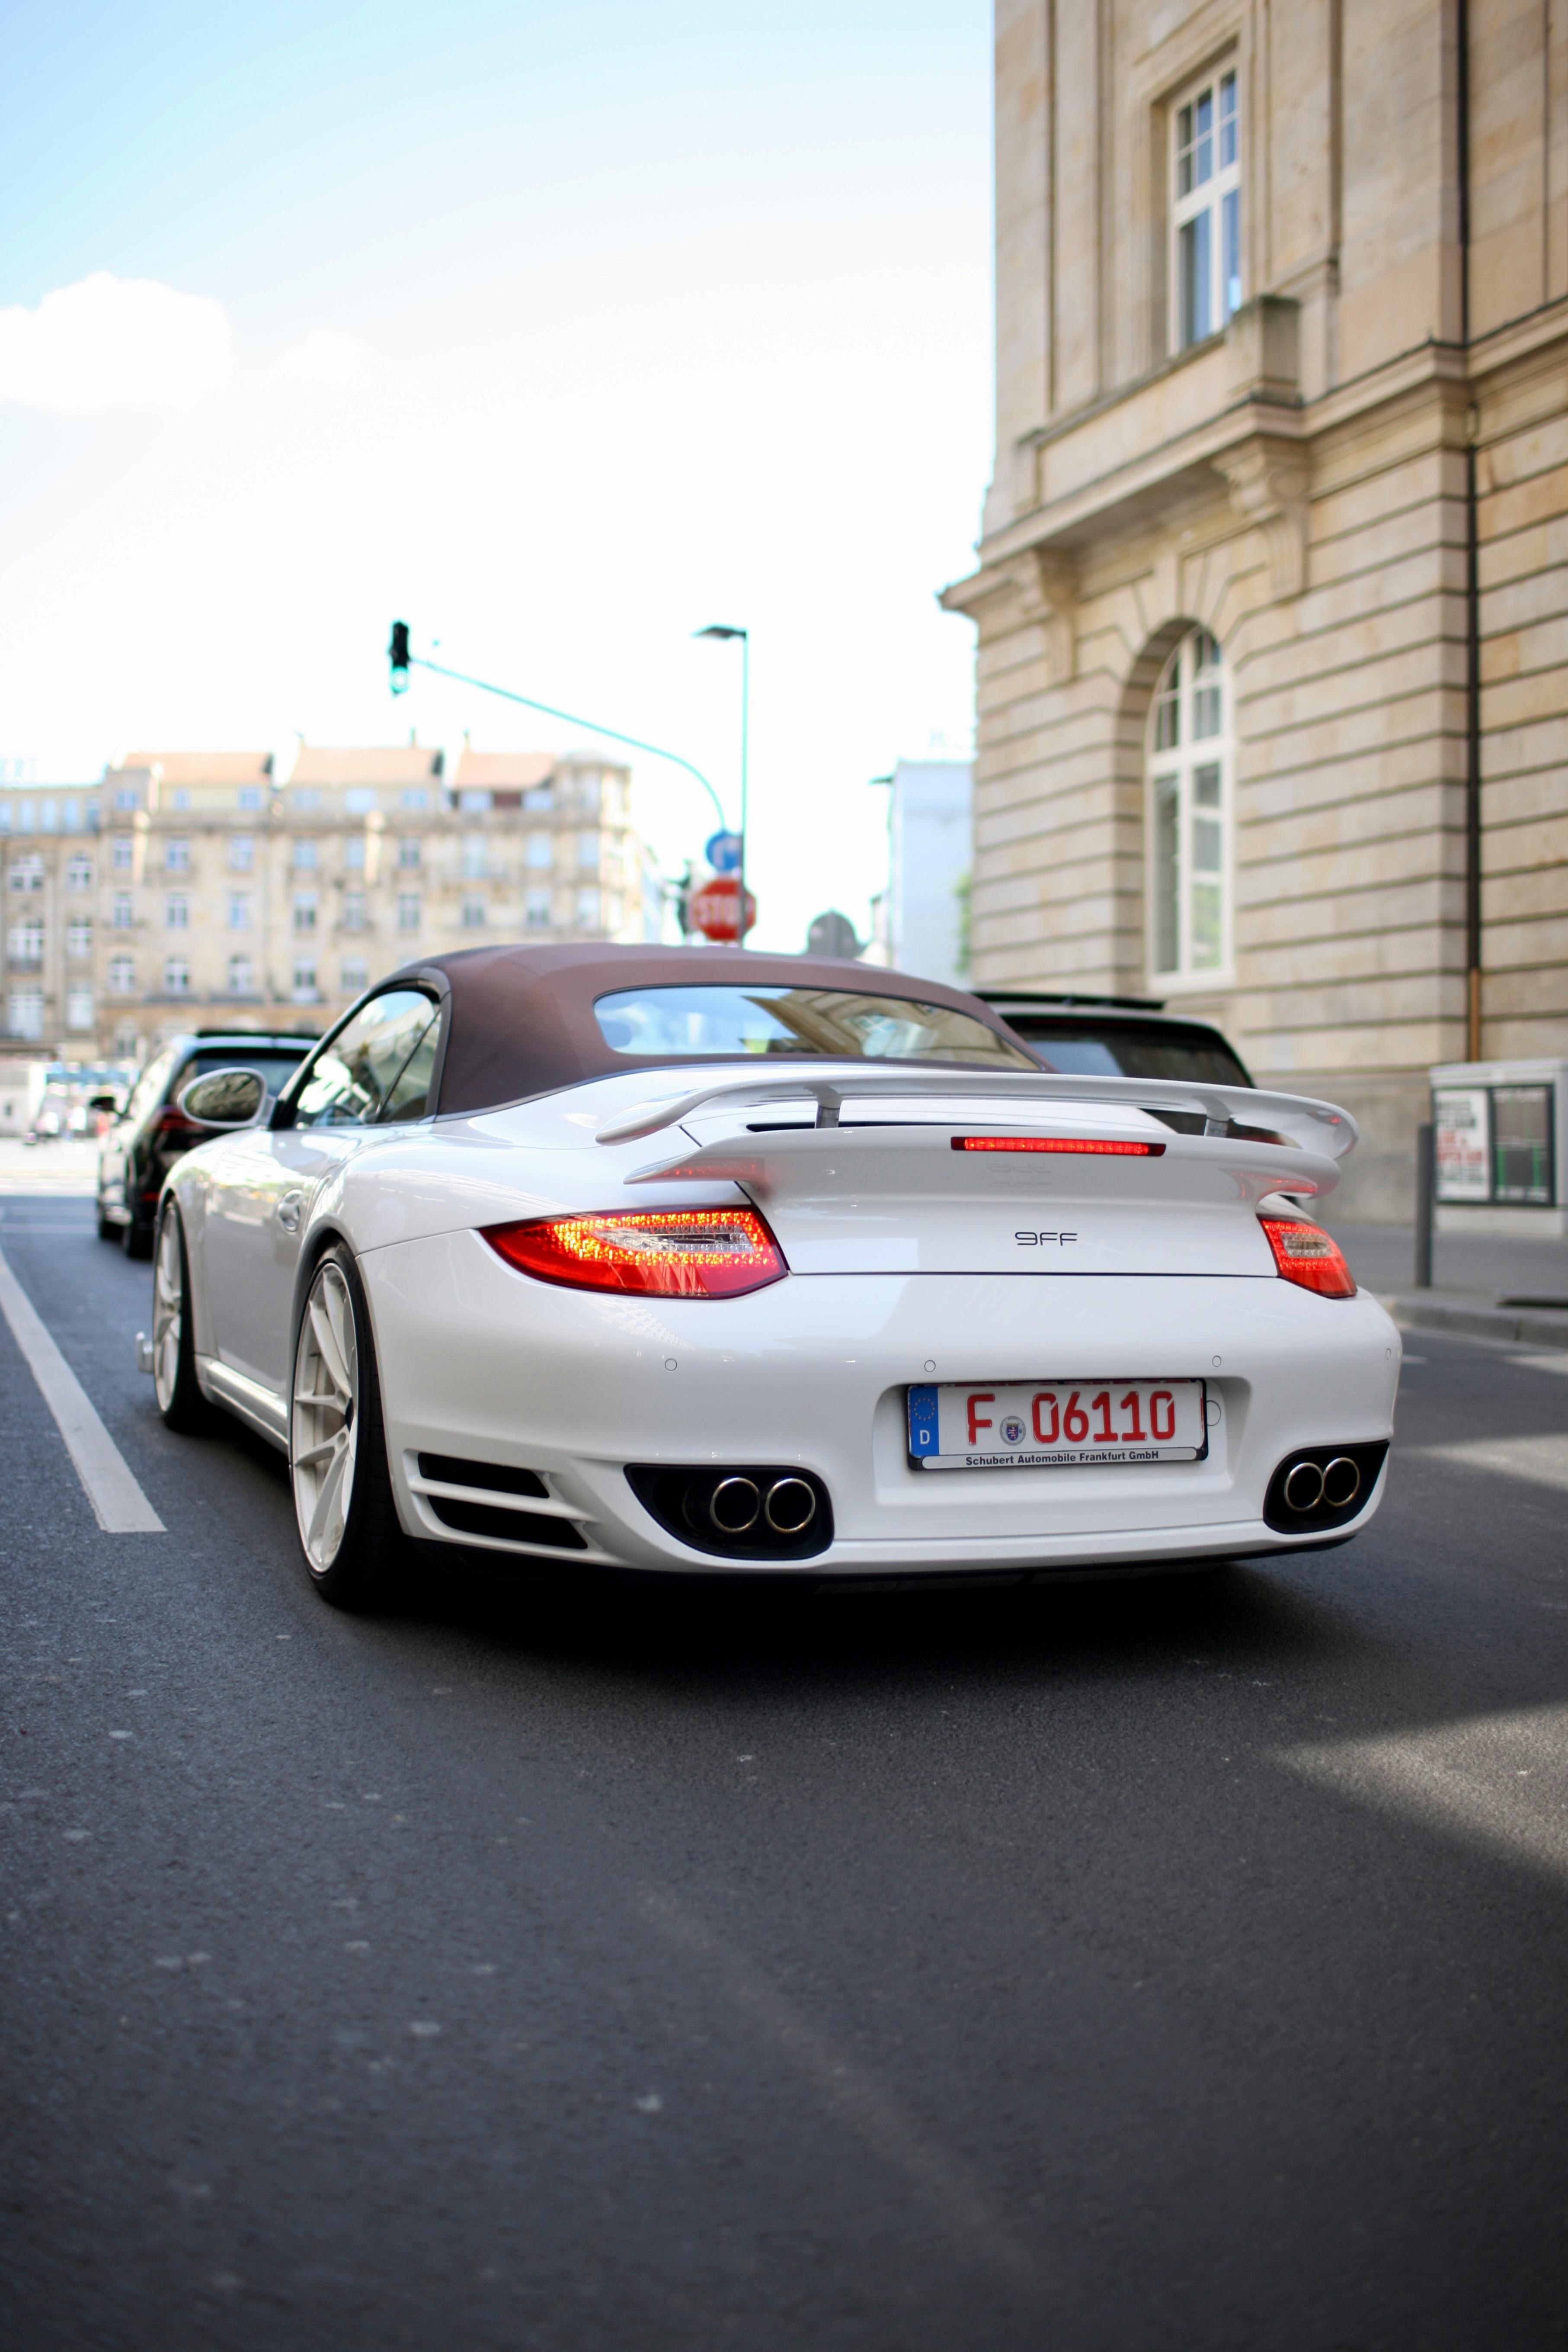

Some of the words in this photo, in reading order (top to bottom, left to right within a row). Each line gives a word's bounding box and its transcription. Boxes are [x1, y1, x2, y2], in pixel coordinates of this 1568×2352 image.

[967, 1393, 995, 1445] F
[1032, 1391, 1175, 1443] 06110
[920, 1430, 930, 1444] D
[966, 1456, 1014, 1465] Schubert
[1018, 1452, 1075, 1463] Automobile
[1079, 1452, 1125, 1461] Frankfurt
[1129, 1450, 1158, 1459] GmbH
